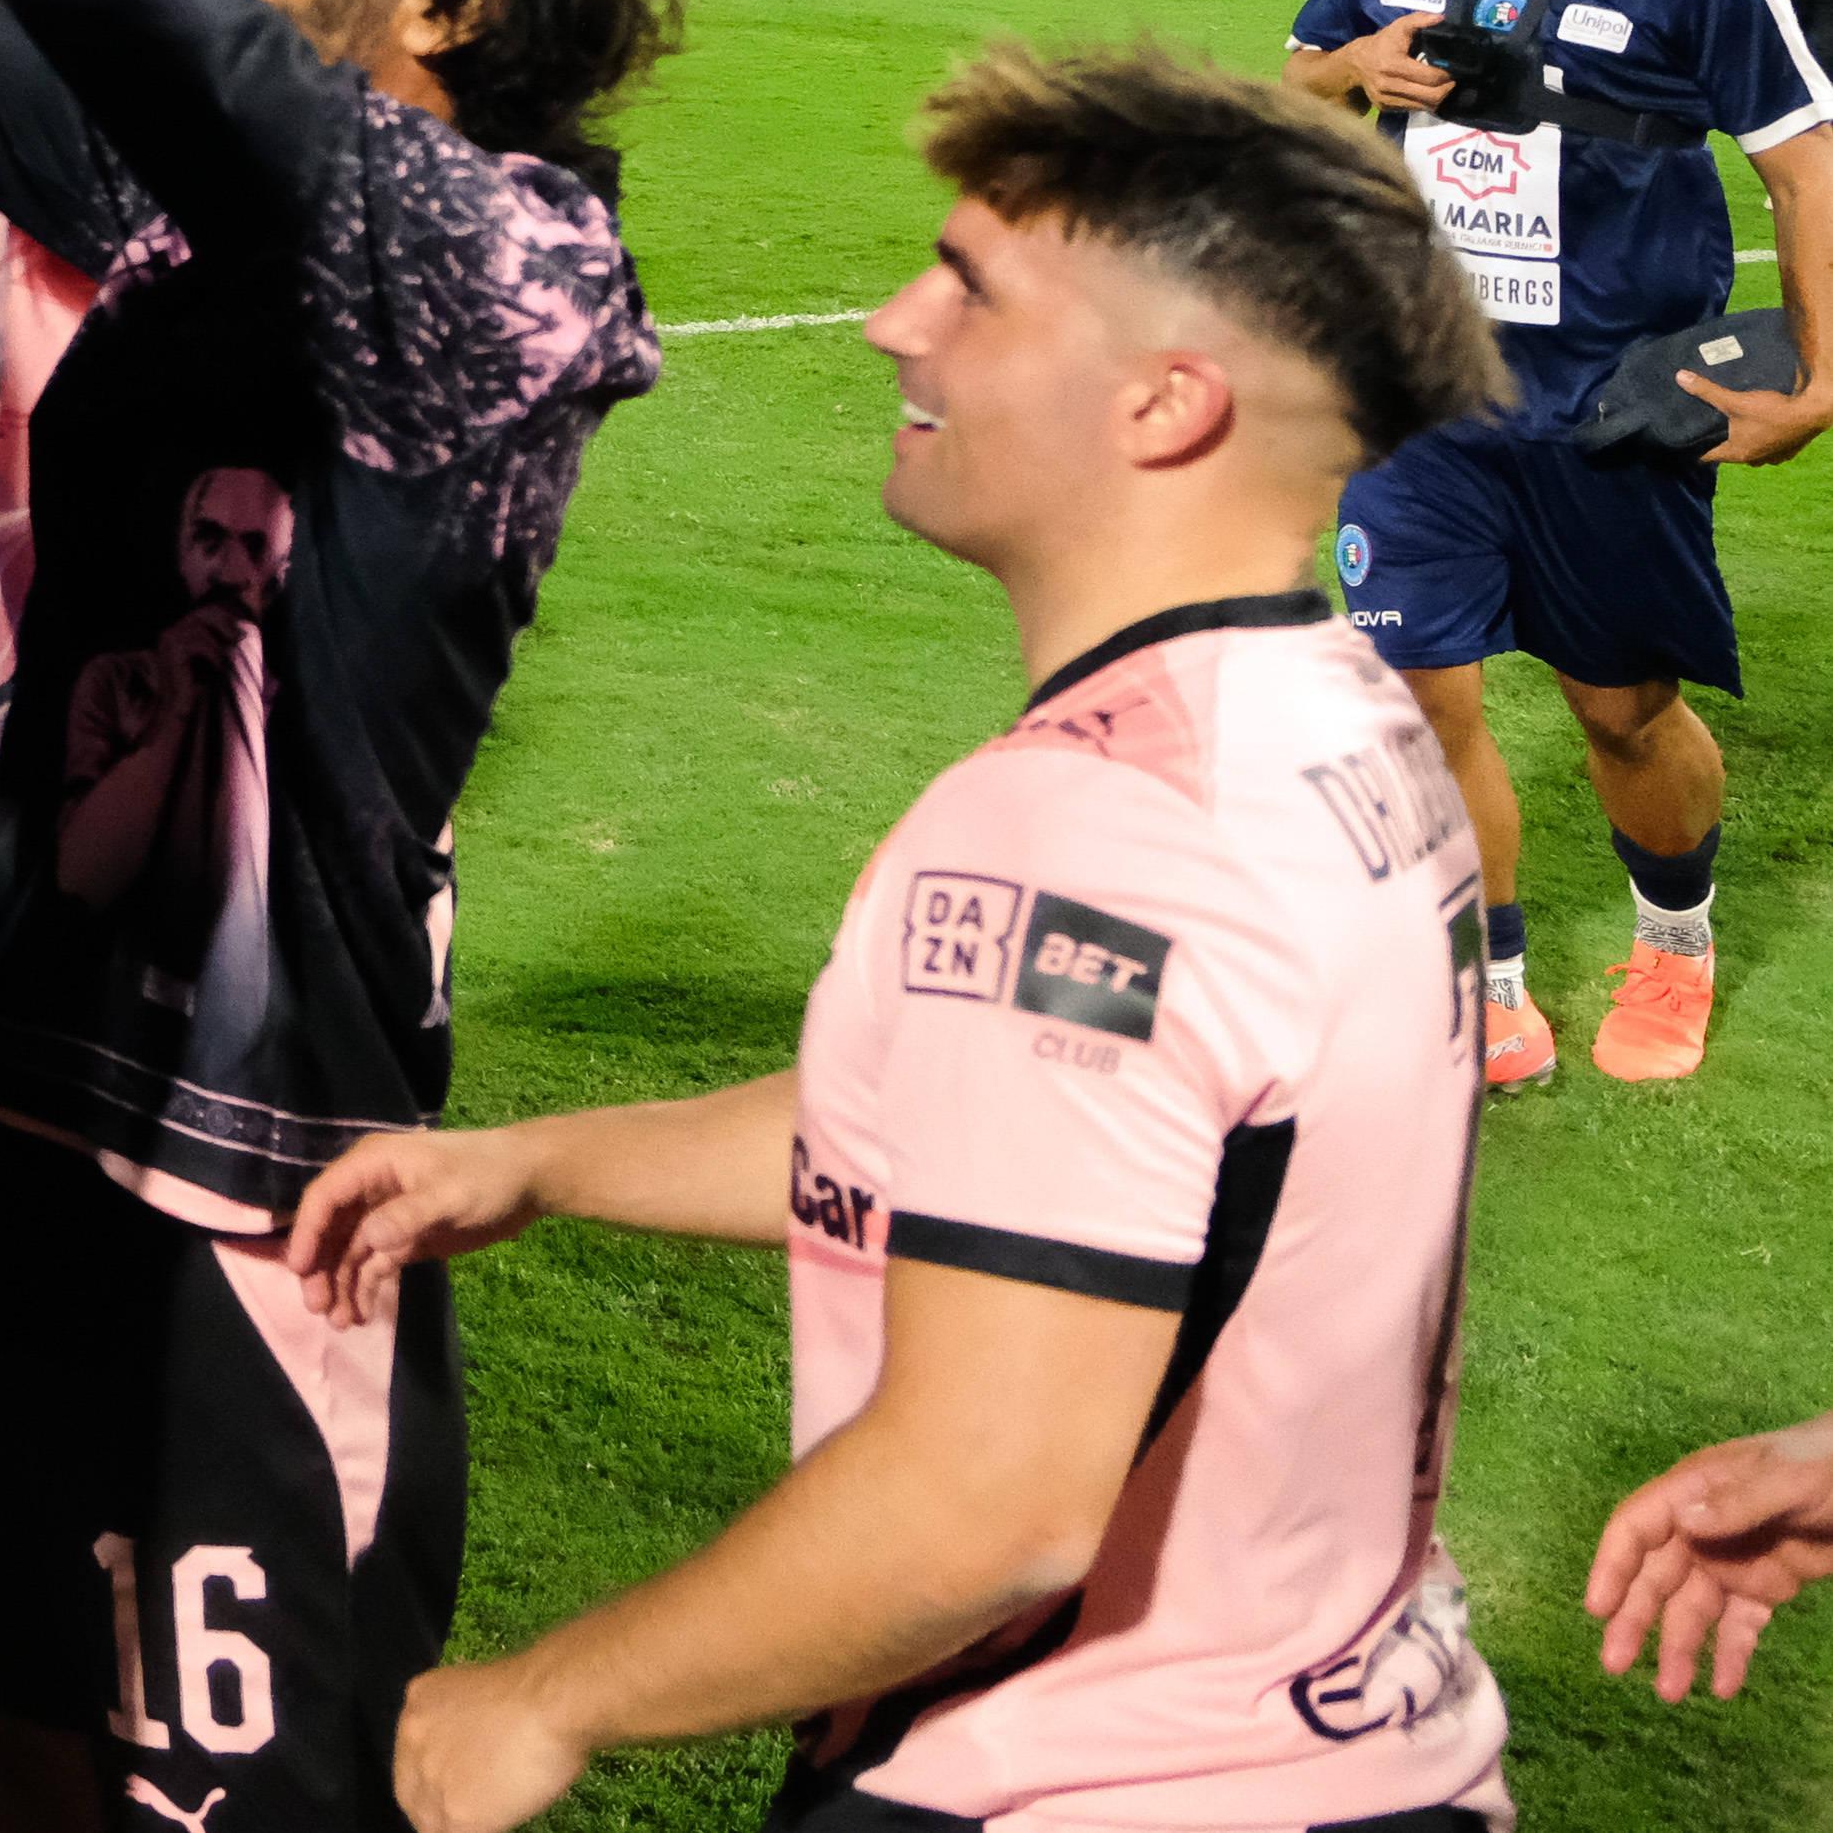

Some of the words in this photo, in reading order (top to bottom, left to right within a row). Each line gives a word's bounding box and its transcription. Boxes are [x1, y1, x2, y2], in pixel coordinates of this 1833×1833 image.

[1572, 8, 1630, 36] Unipol
[1453, 148, 1503, 174] GDM
[1444, 203, 1552, 239] MARIA
[1471, 272, 1553, 307] BERGS
[1351, 610, 1402, 627] OVA
[1036, 931, 1148, 995] BET
[1032, 1030, 1121, 1075] CLUB
[92, 1530, 277, 1756] 16
